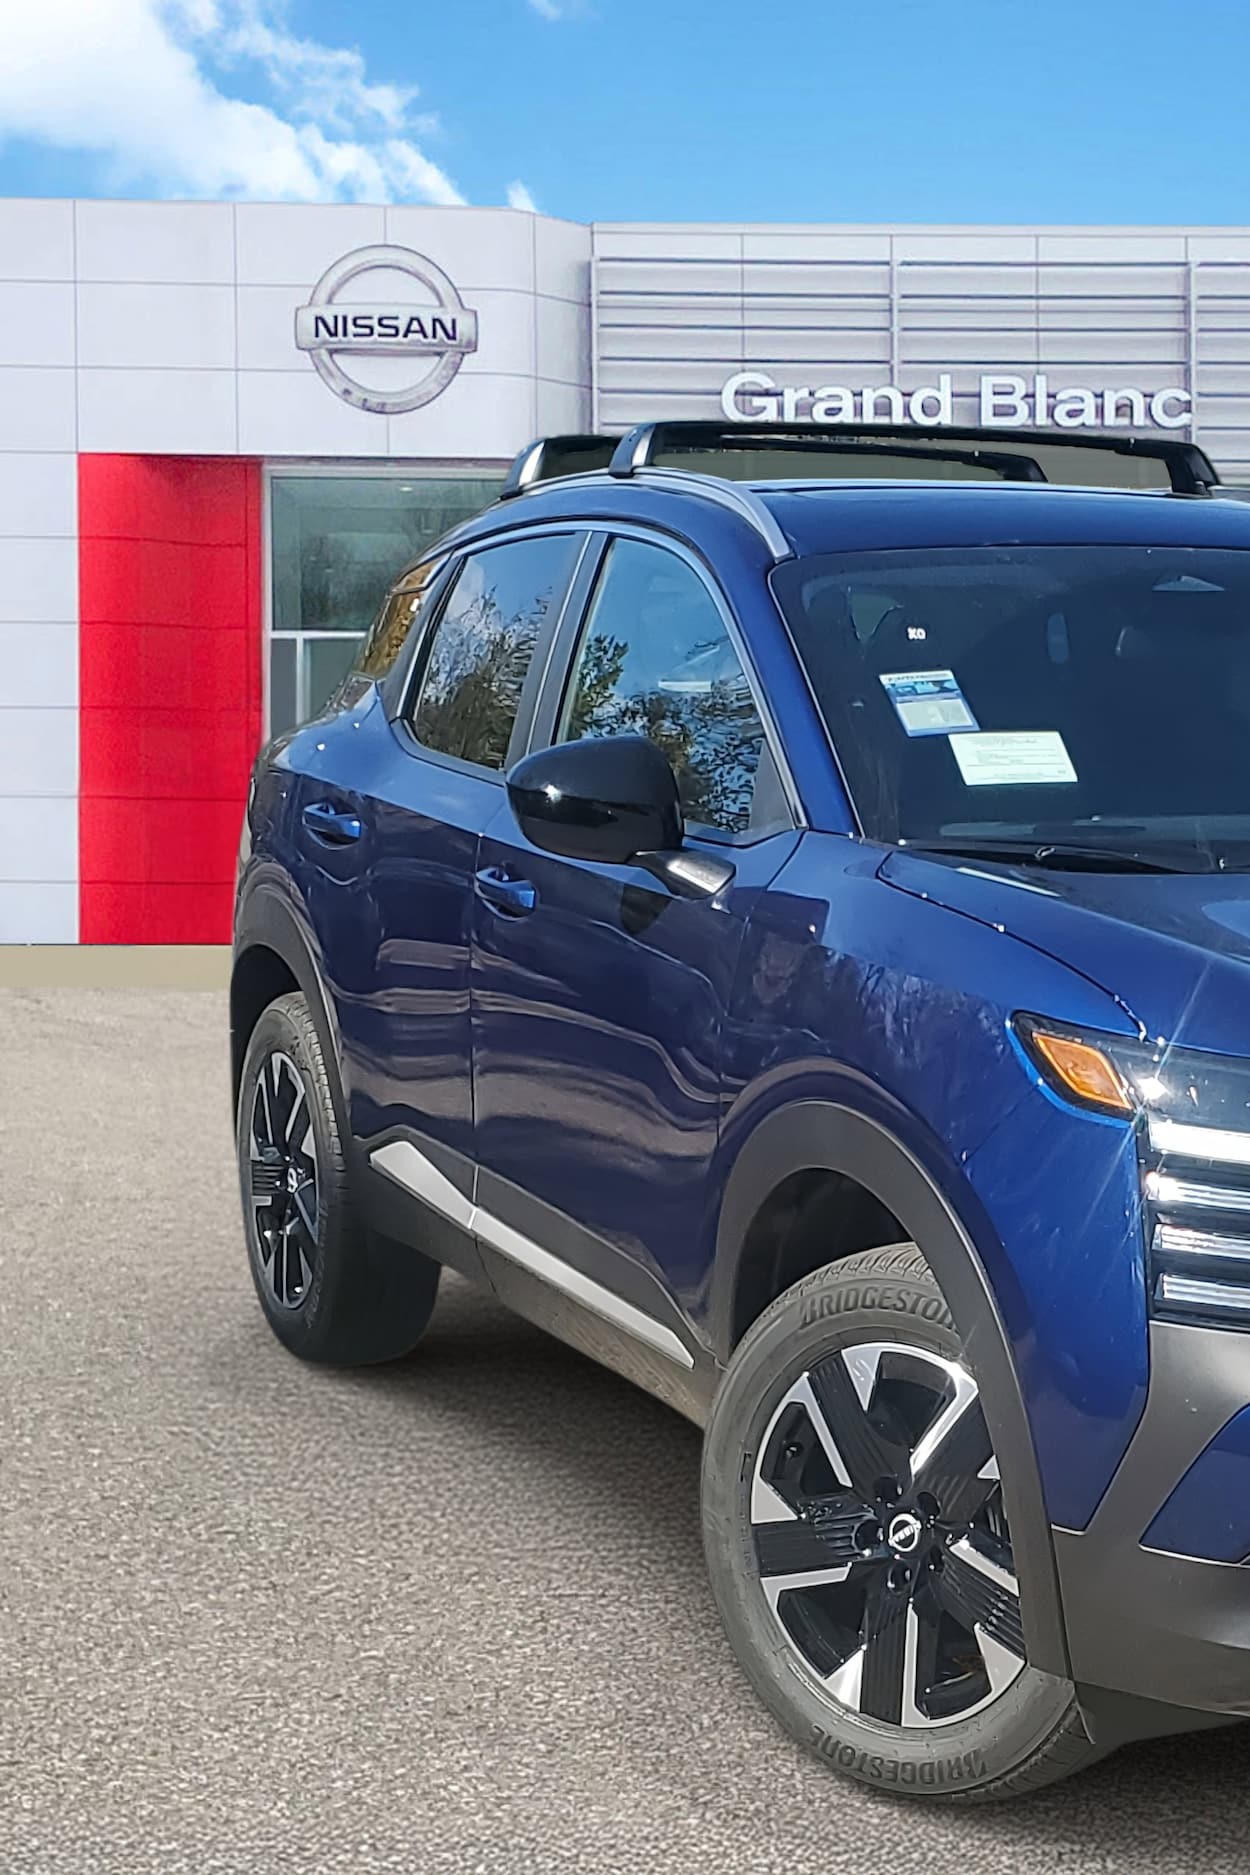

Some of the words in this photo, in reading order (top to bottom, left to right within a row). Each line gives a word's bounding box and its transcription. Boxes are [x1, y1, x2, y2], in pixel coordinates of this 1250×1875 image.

[314, 314, 457, 341] NISSAN
[719, 371, 952, 426] Grand
[979, 373, 1193, 428] Blanc
[800, 1285, 962, 1334] BRIDGESTO
[808, 1725, 988, 1785] BRIDGESTONE
